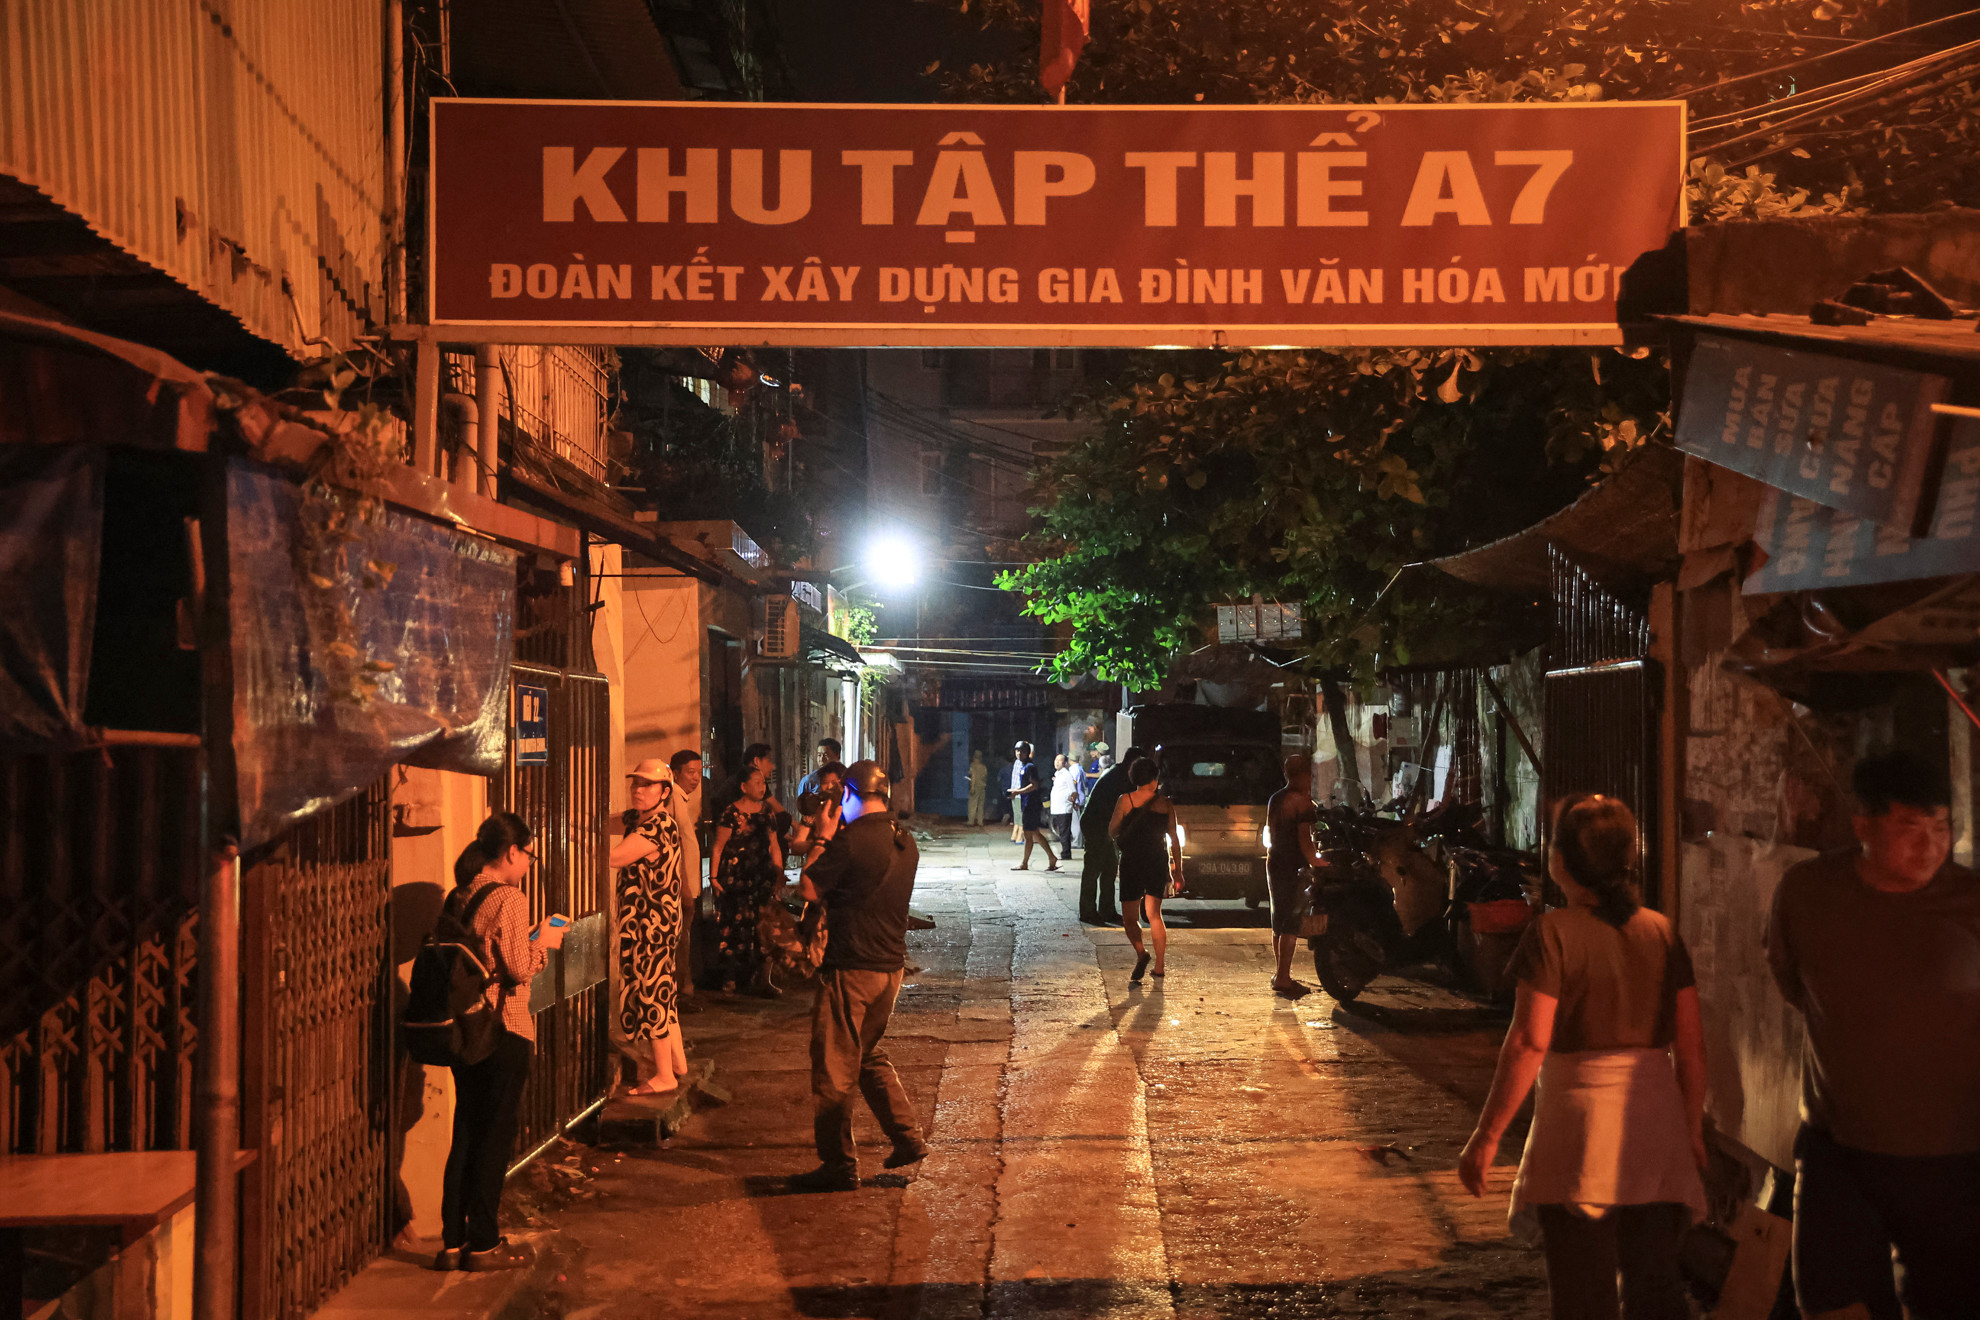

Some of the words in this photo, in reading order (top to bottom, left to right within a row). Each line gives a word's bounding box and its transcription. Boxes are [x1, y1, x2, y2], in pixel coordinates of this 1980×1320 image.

[544, 147, 812, 226] KHU
[842, 131, 1096, 244] TẬP
[1125, 110, 1383, 228] THỂ
[1400, 149, 1576, 227] A7
[489, 254, 632, 300] ĐOÀN
[651, 247, 745, 302] KẾT
[760, 257, 861, 303] XÂY
[878, 263, 1019, 314] DỰNG
[1037, 267, 1124, 305] GIA
[1138, 257, 1264, 305] ĐÌNH
[1279, 257, 1385, 305] VĂN
[1402, 255, 1507, 305] HÓA
[1720, 366, 1752, 445] MUA
